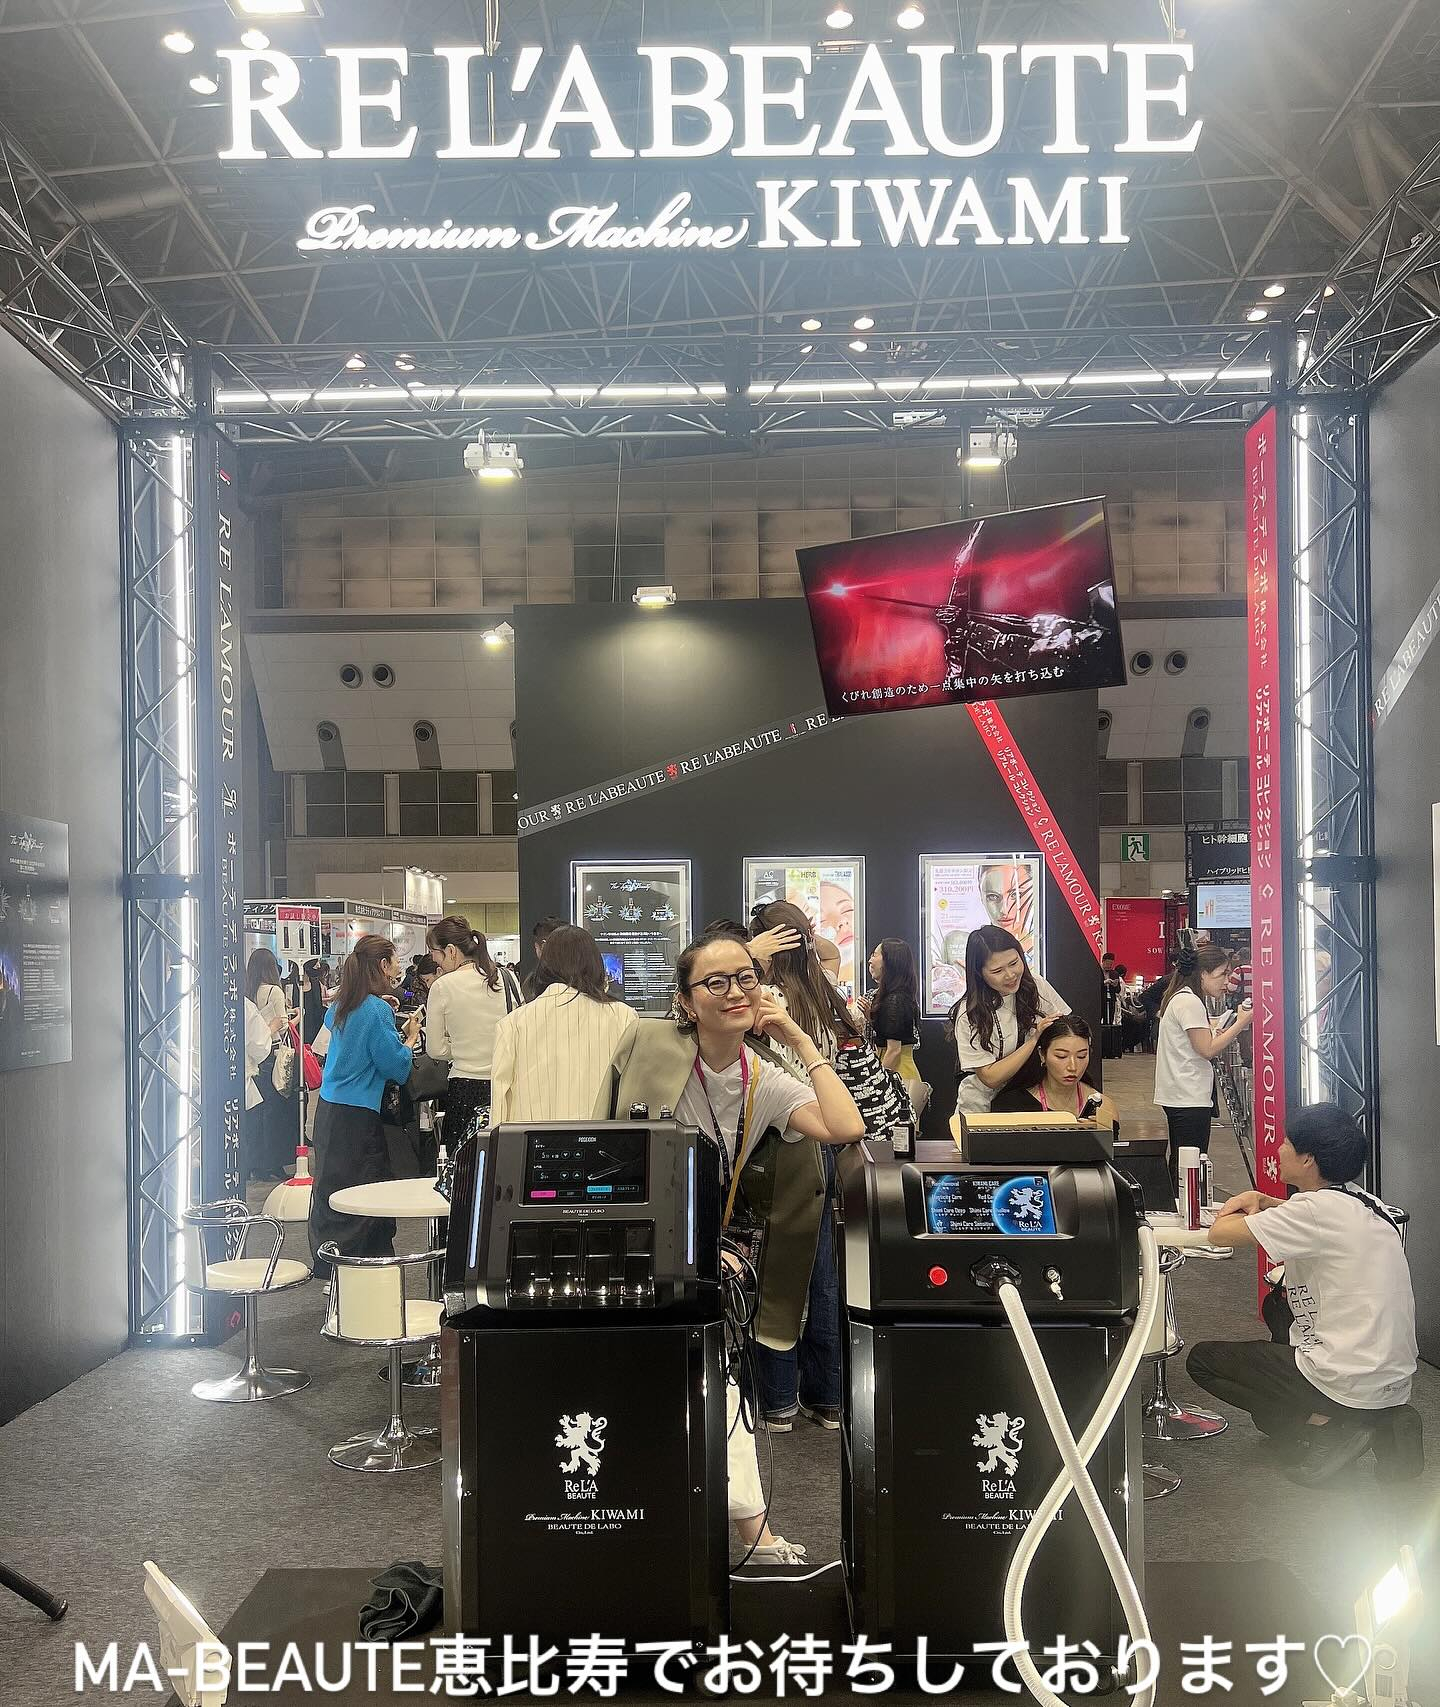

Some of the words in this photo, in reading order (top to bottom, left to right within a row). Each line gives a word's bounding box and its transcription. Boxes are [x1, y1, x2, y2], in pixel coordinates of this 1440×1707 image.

[297, 204, 521, 251] Premium
[527, 192, 749, 251] Machine
[756, 176, 1131, 248] KIWAMI
[218, 510, 232, 571] RE
[218, 577, 236, 763] L'AMOUR
[841, 664, 1065, 703] くびれ創造のため一点集中の矢を打ち込む
[517, 810, 551, 831] OUR
[565, 797, 587, 815] RE
[588, 770, 667, 807] L'ABEAUTE
[680, 757, 702, 775] RE
[703, 729, 783, 767] L'ABEAUTE
[805, 713, 829, 731] RE
[1041, 829, 1061, 853] RE
[1053, 851, 1093, 917] L'AMOUR
[1260, 917, 1273, 967] RE
[1260, 980, 1277, 1146] L'AMOUR
[567, 1492, 597, 1500] BEAUTE
[590, 1508, 645, 1520] KIWAMI
[984, 1492, 1014, 1500] BEAUTE
